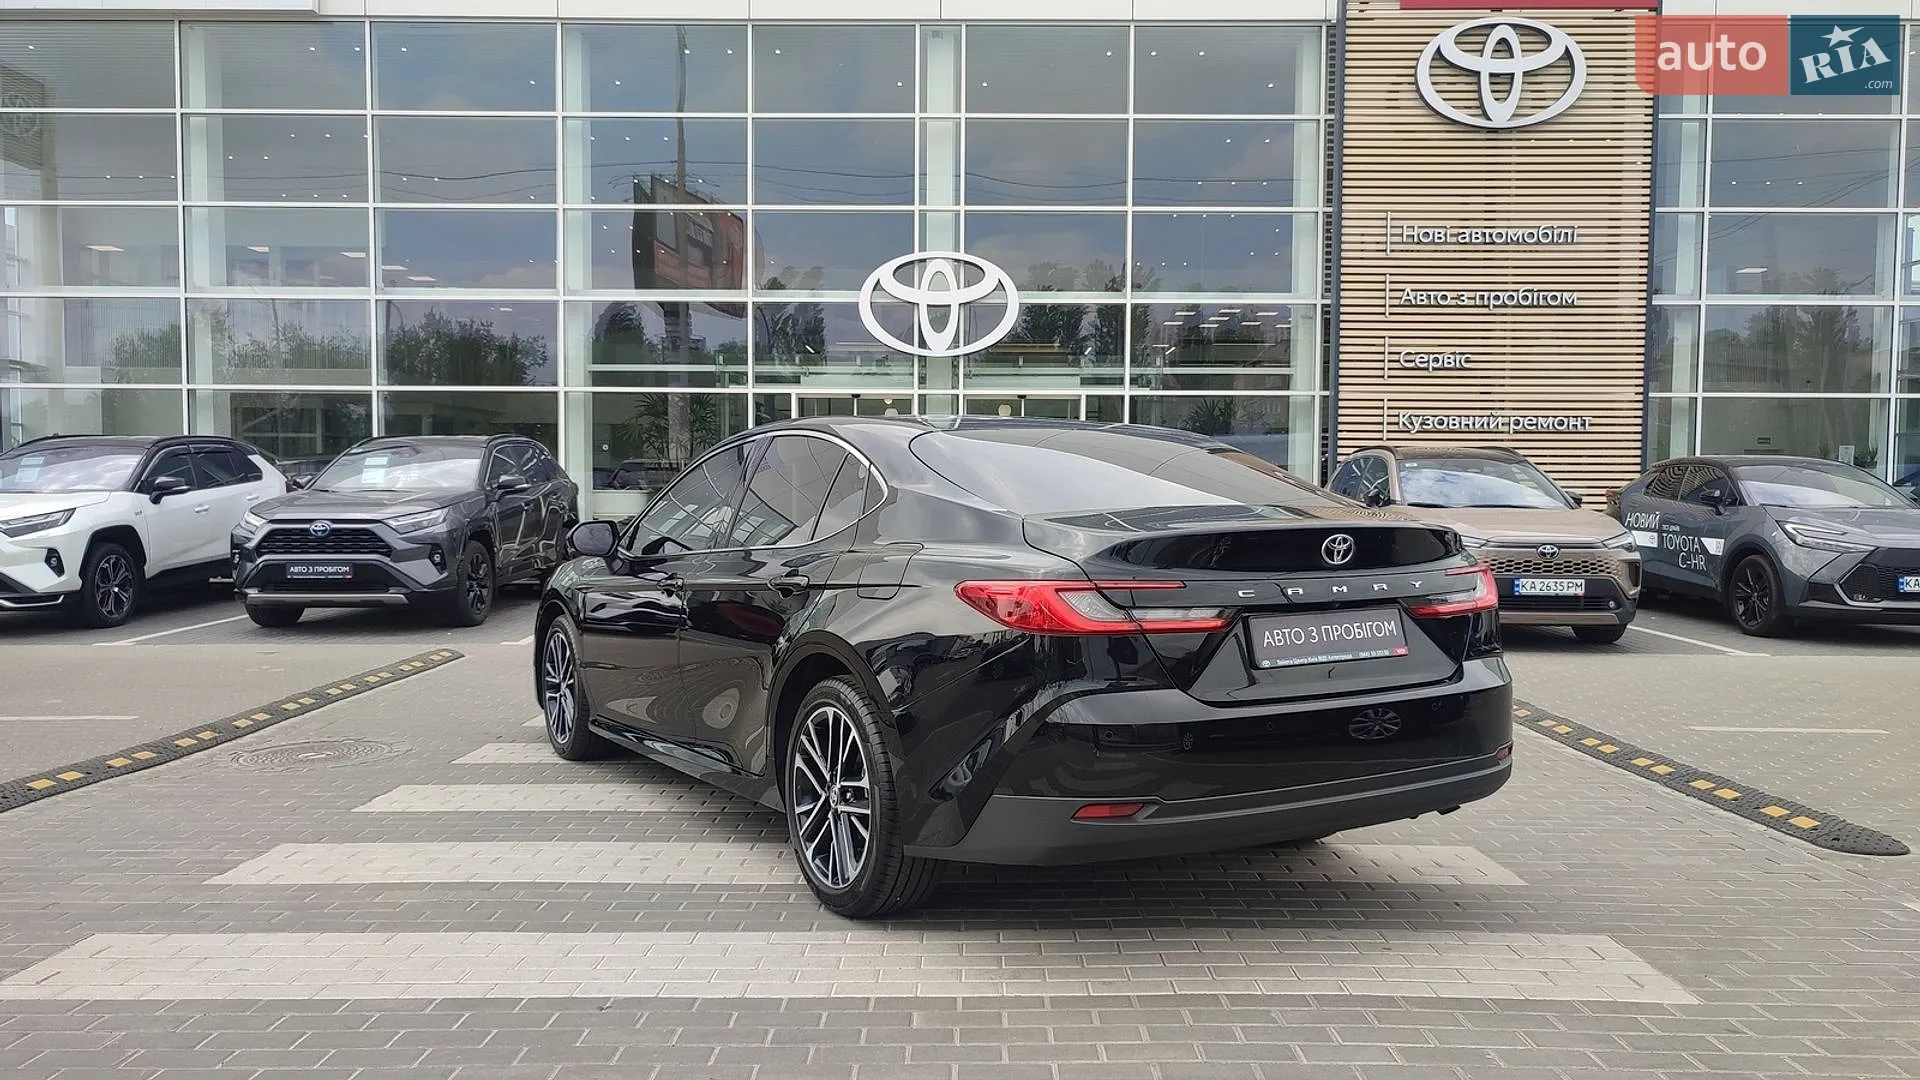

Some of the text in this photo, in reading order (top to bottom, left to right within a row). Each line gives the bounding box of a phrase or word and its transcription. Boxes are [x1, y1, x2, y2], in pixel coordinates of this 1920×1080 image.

[1402, 224, 1578, 243] Нові автомобілі
[1400, 287, 1577, 310] Авто з пробігом
[1400, 350, 1472, 371] Сервіс
[1399, 411, 1592, 433] Кузовний ремонт
[1625, 512, 1660, 529] НОВИЙ
[1662, 533, 1701, 553] TOYOTA
[1679, 552, 1707, 570] C-HR
[1238, 580, 1423, 597] CAMRY
[1520, 581, 1537, 591] KA
[1539, 581, 1565, 591] 2635
[1263, 628, 1305, 647] АВТО
[1321, 620, 1397, 641] ПРОБІГОМ
